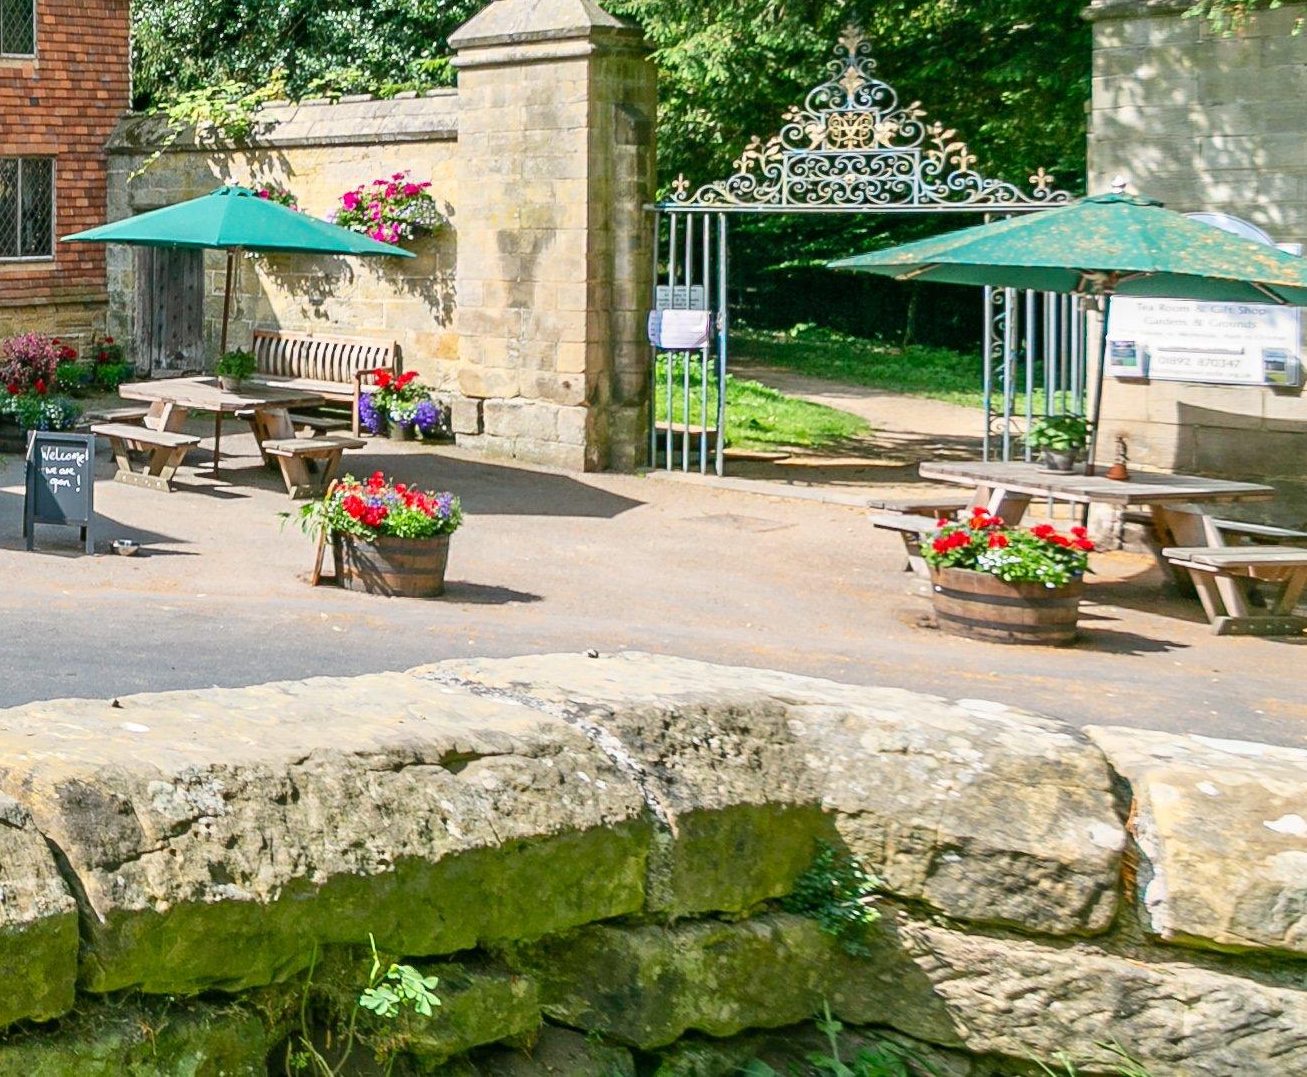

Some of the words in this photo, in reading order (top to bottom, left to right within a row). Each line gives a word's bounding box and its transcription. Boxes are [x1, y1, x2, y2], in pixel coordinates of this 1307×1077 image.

[1136, 302, 1154, 312] Tea
[1158, 303, 1190, 313] Room
[1210, 305, 1233, 314] Gift
[1237, 305, 1267, 316] Shop
[1143, 316, 1188, 326] Gardens
[1208, 318, 1258, 329] Grounds
[1157, 356, 1191, 366] 01892
[1197, 358, 1241, 369] 870347
[40, 445, 89, 467] Welcome!
[45, 466, 58, 475] we
[58, 467, 76, 476] are
